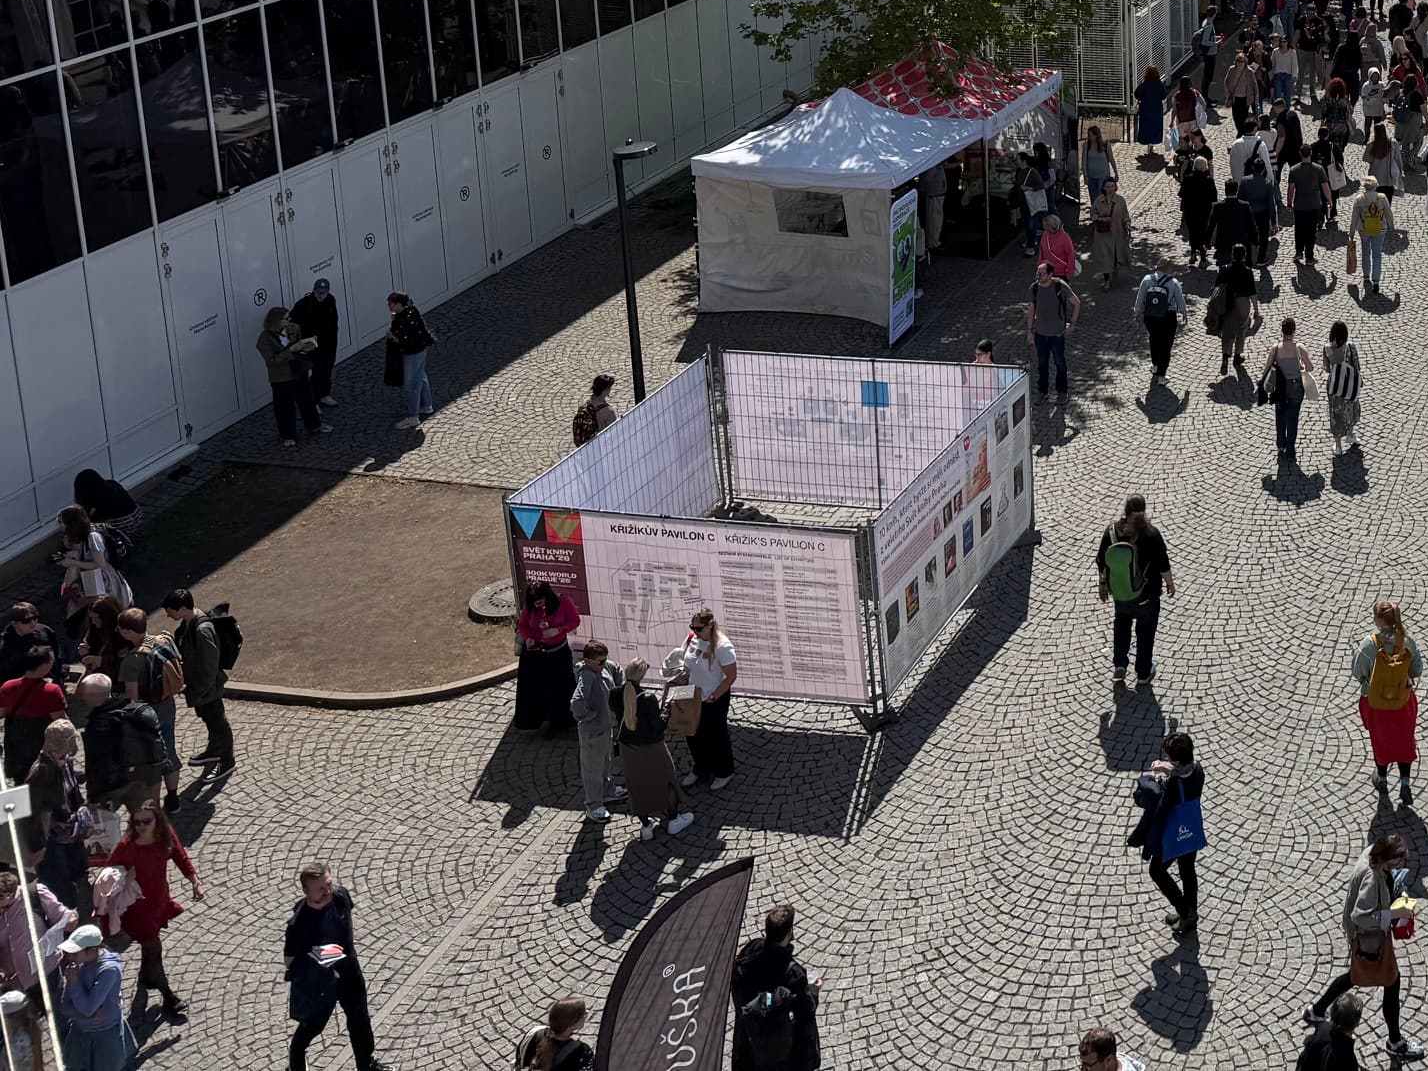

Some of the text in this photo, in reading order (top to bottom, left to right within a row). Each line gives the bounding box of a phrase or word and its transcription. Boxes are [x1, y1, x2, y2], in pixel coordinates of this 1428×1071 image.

[610, 523, 715, 542] KŘIŽÍKŮV PAVILON C
[769, 539, 815, 551] PAVILION
[817, 542, 825, 552] C
[523, 552, 555, 561] PRAHA
[546, 548, 574, 557] KNIHY
[549, 571, 577, 579] WORLD
